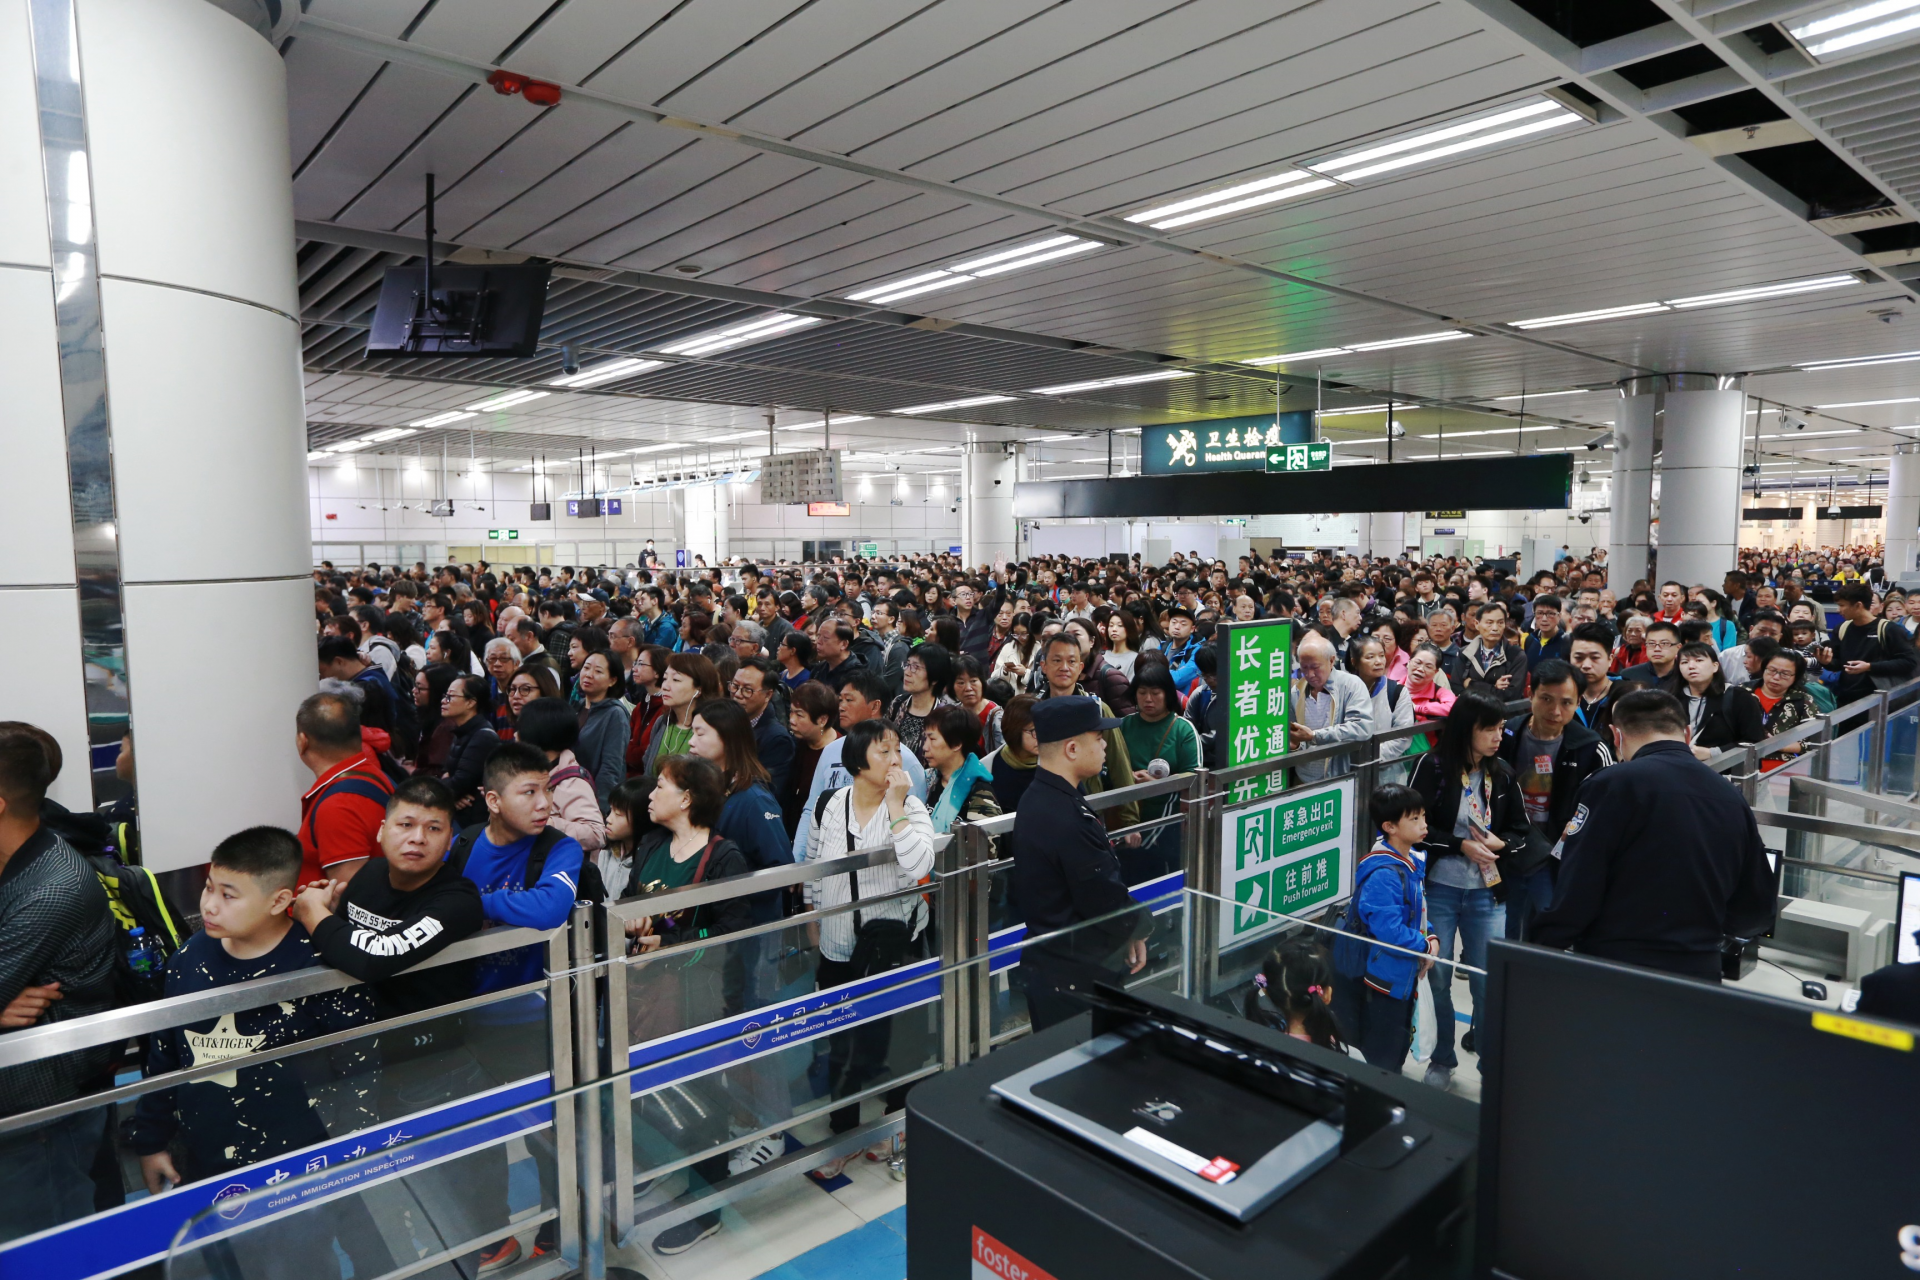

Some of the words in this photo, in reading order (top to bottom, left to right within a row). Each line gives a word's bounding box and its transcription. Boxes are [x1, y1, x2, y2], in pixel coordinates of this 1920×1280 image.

[1205, 423, 1284, 448] 卫生检疫
[1205, 451, 1232, 462] Health
[1283, 799, 1334, 831] 紧急出口
[1282, 825, 1320, 844] Emergency
[1320, 819, 1333, 832] exit
[1285, 858, 1327, 891] 往前推
[1283, 890, 1300, 905] Push
[1301, 878, 1329, 898] forward
[771, 1033, 789, 1043] CHINA
[790, 1021, 825, 1037] IMMIGRATION
[826, 1011, 857, 1026] INSPECTION
[192, 1035, 253, 1049] CAT&TIGER
[268, 1193, 297, 1208] CHINA
[301, 1172, 360, 1197] IMMIGRATION
[364, 1154, 415, 1176] INSPECTION
